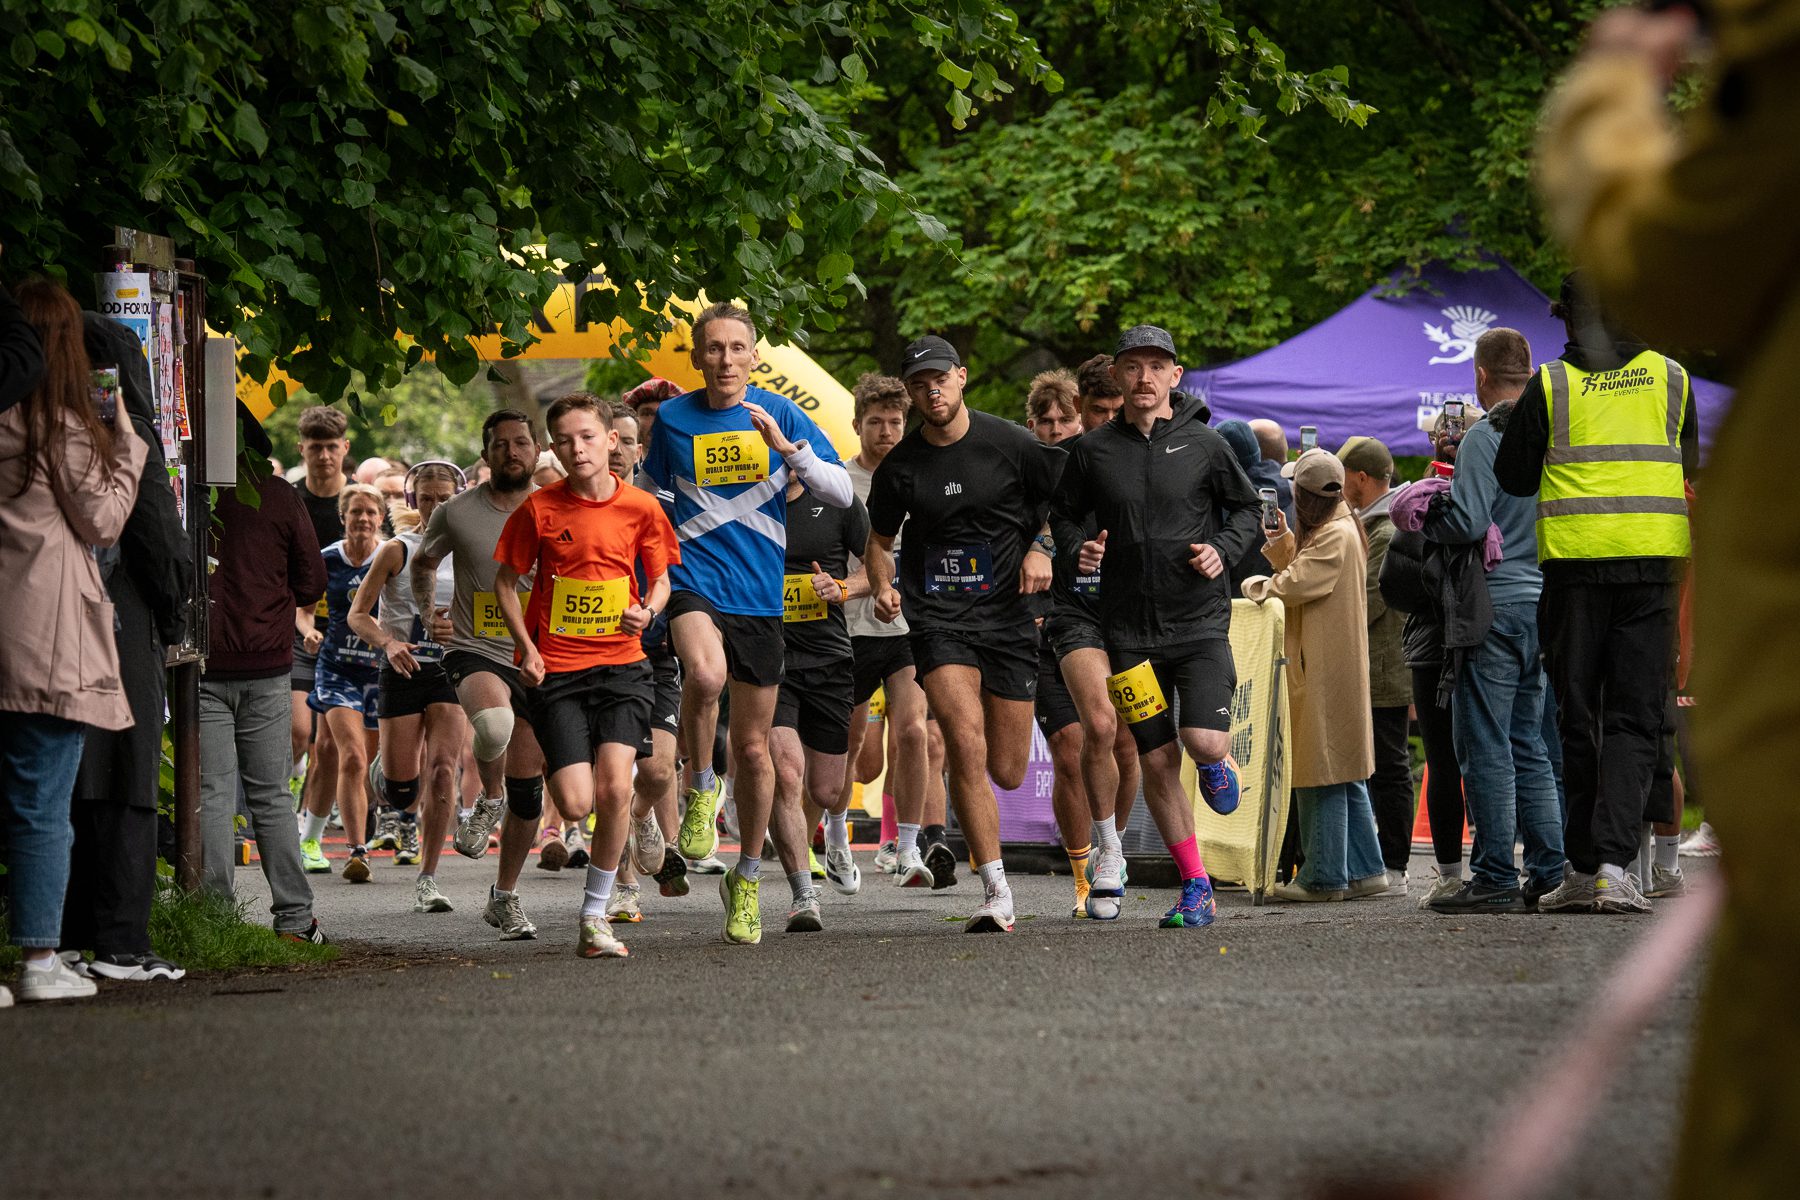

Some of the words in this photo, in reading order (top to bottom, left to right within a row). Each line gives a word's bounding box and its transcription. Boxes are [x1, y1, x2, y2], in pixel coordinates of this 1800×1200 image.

[123, 302, 140, 314] FOR
[1604, 370, 1620, 380] UP
[1621, 367, 1648, 379] AND
[1599, 376, 1655, 391] RUNNING
[767, 373, 820, 411] AND
[1418, 391, 1444, 406] THE
[1613, 388, 1640, 397] EVENTS
[705, 445, 741, 465] 533
[705, 466, 723, 475] WORLD
[723, 465, 734, 473] CUP
[734, 463, 760, 472] WARM-UP
[944, 481, 962, 496] alto
[940, 557, 960, 574] 15
[934, 574, 951, 583] WORLD
[950, 574, 961, 583] CUP
[960, 574, 984, 583] WARM-UP
[783, 587, 801, 603] 41
[484, 604, 504, 620] 50
[565, 594, 604, 615] 552
[562, 615, 582, 624] WORLD
[582, 617, 595, 625] CUP
[595, 614, 620, 624] WARM-UP
[1035, 769, 1053, 798] EXP
